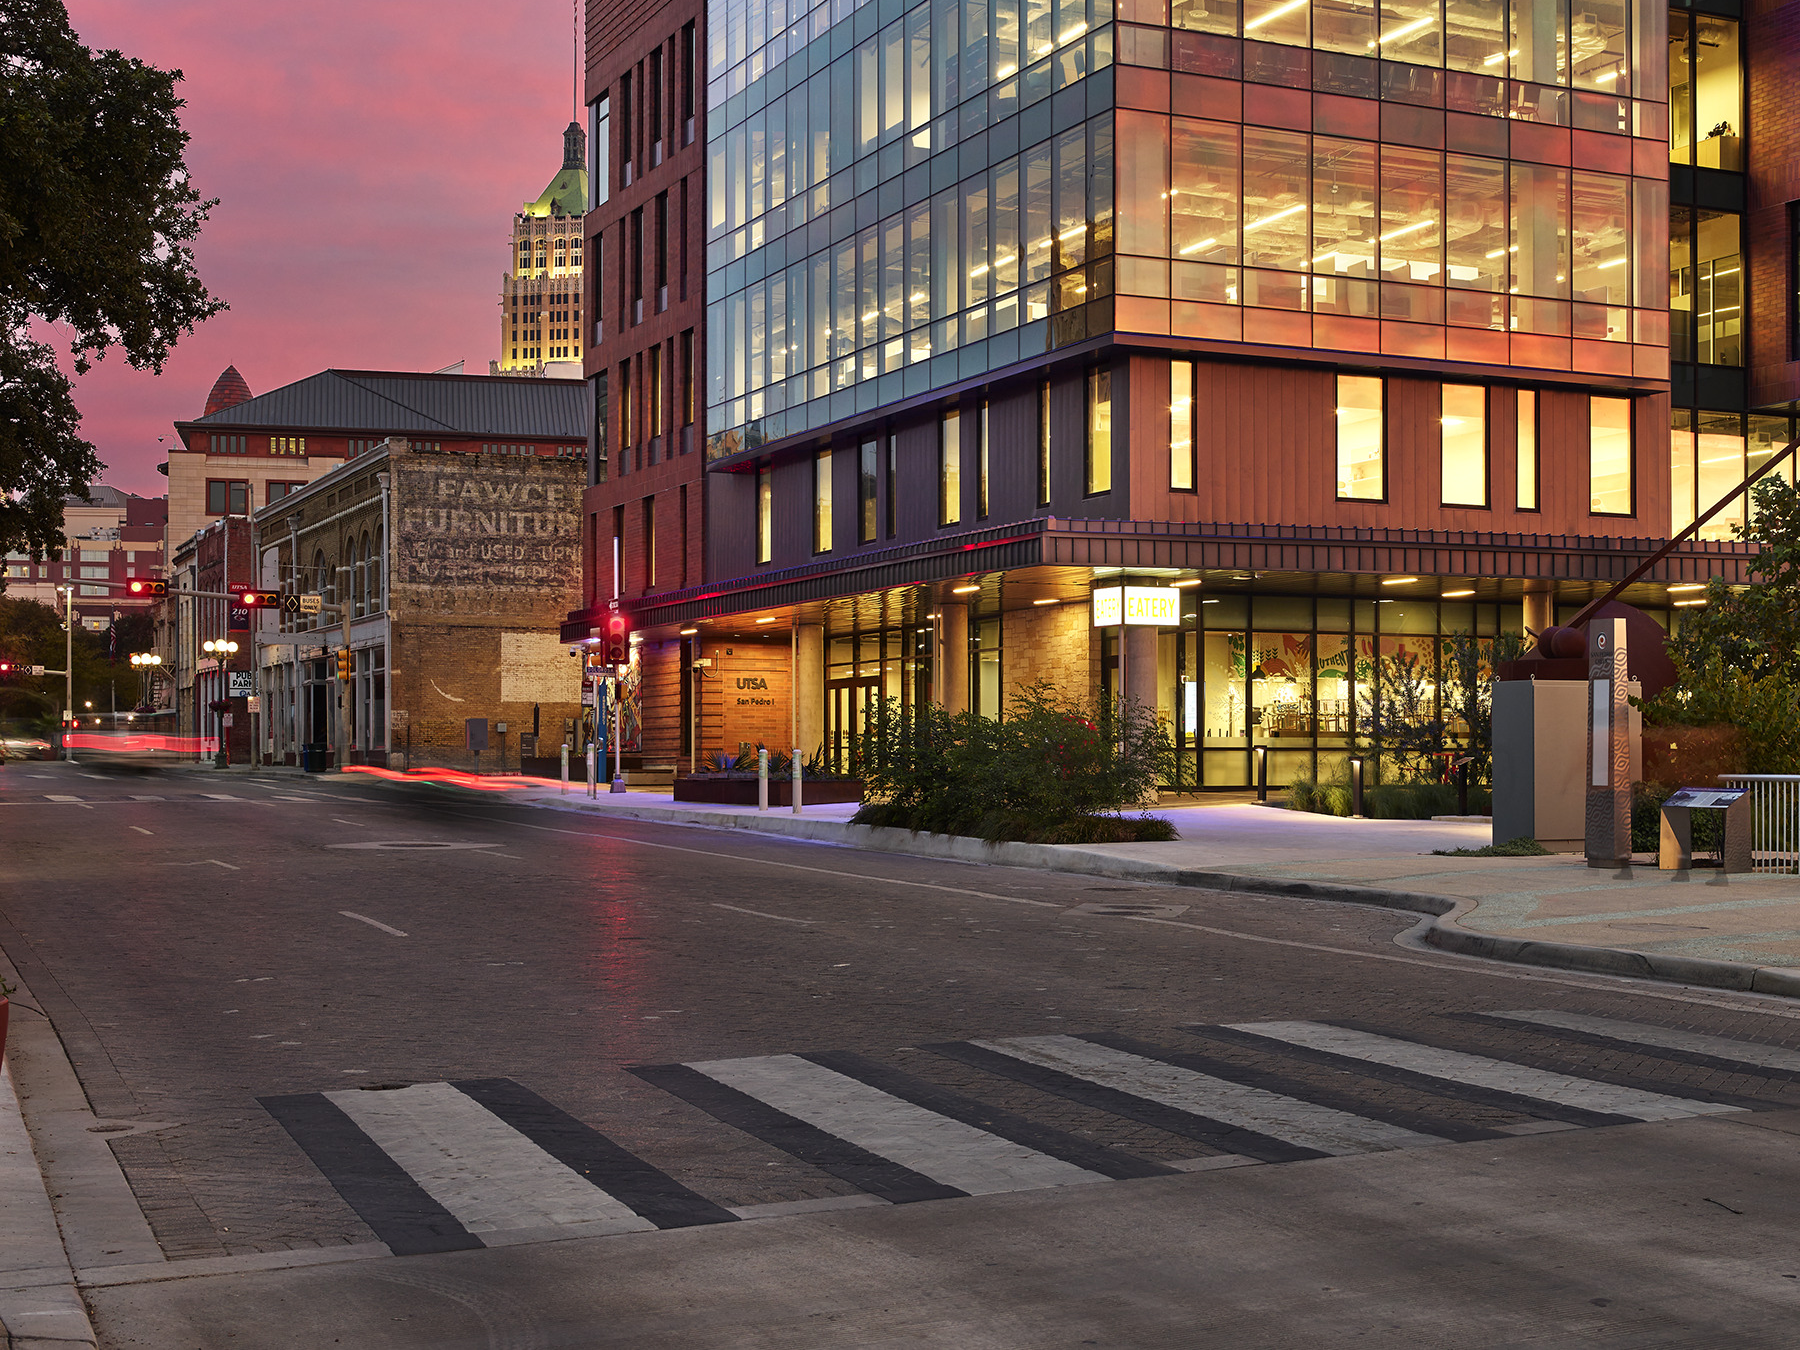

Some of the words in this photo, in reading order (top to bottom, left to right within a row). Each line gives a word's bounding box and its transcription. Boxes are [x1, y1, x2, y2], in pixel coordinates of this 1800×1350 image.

[1096, 597, 1120, 619] EATERY
[1128, 597, 1176, 618] EATERY
[737, 678, 768, 689] UTSA
